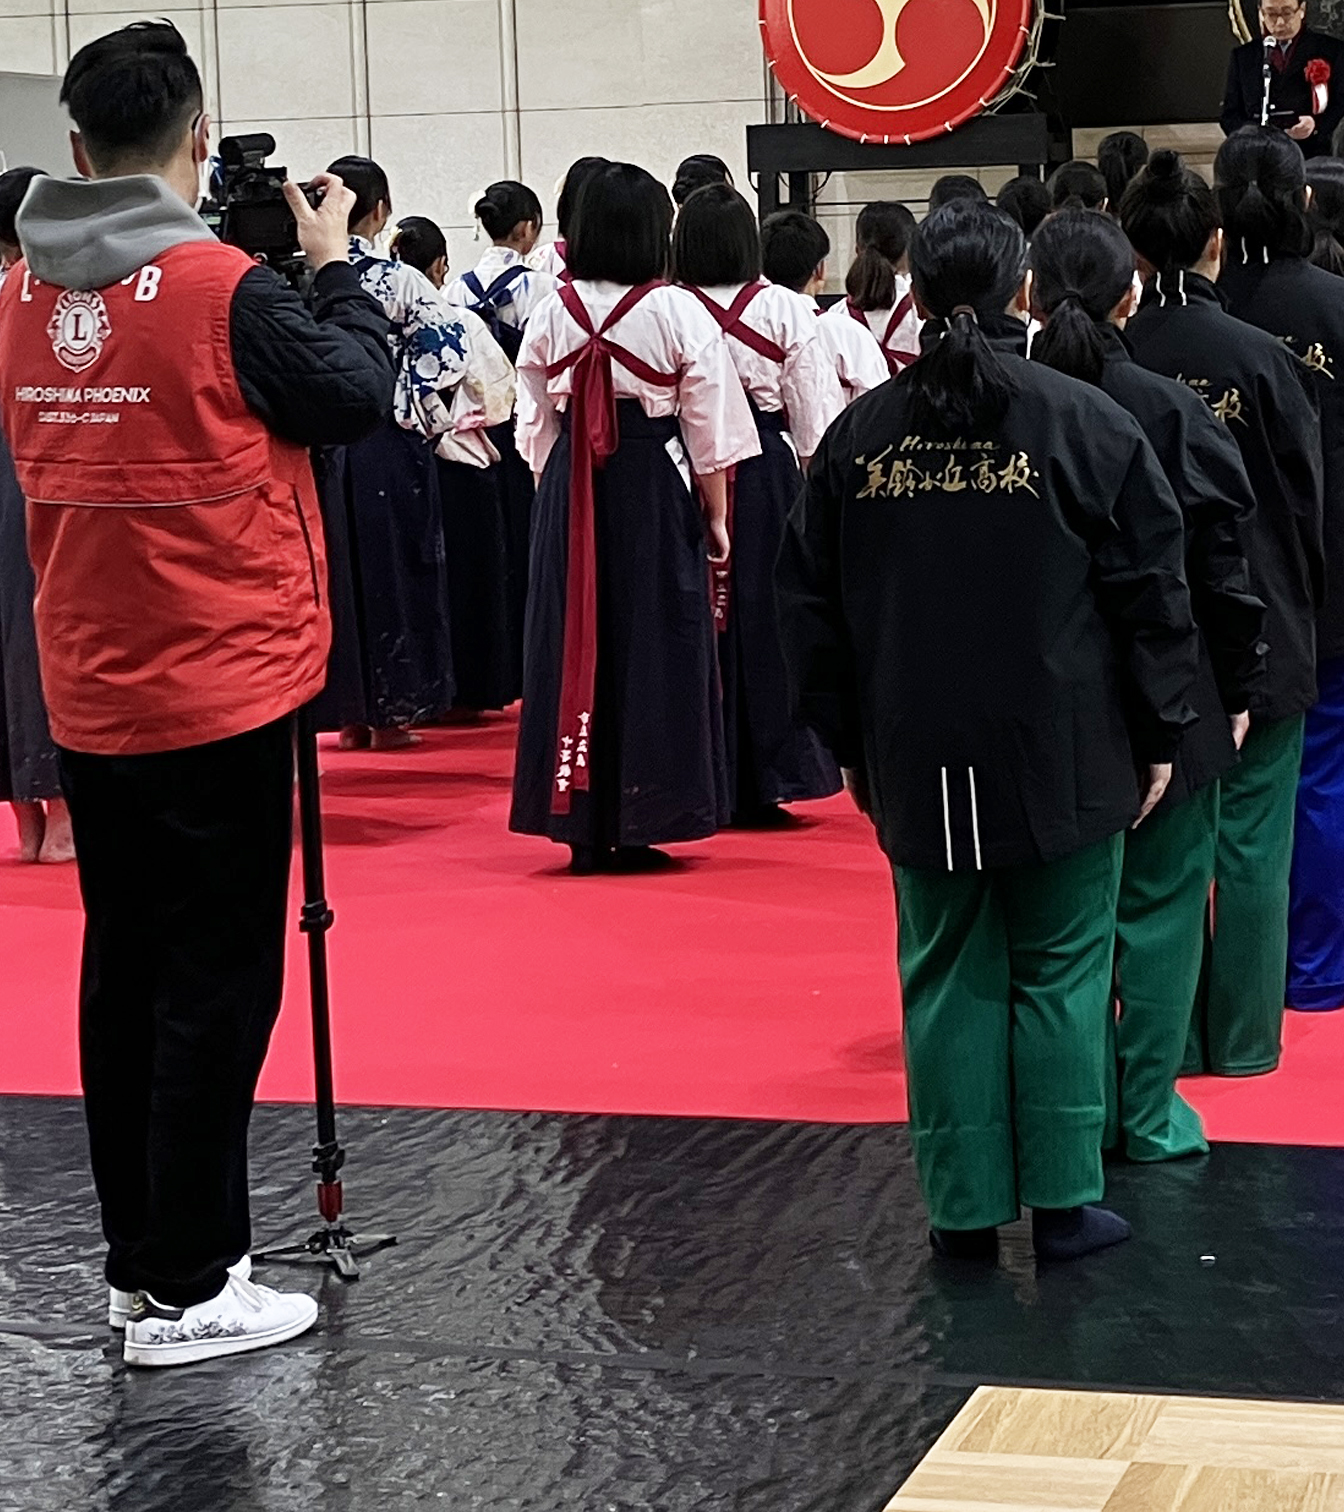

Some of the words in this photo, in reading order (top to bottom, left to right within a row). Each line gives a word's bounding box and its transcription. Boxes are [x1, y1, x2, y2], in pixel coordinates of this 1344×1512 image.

[71, 313, 88, 341] L
[15, 386, 82, 403] HIROSHIMA
[84, 386, 151, 403] PHOENIX
